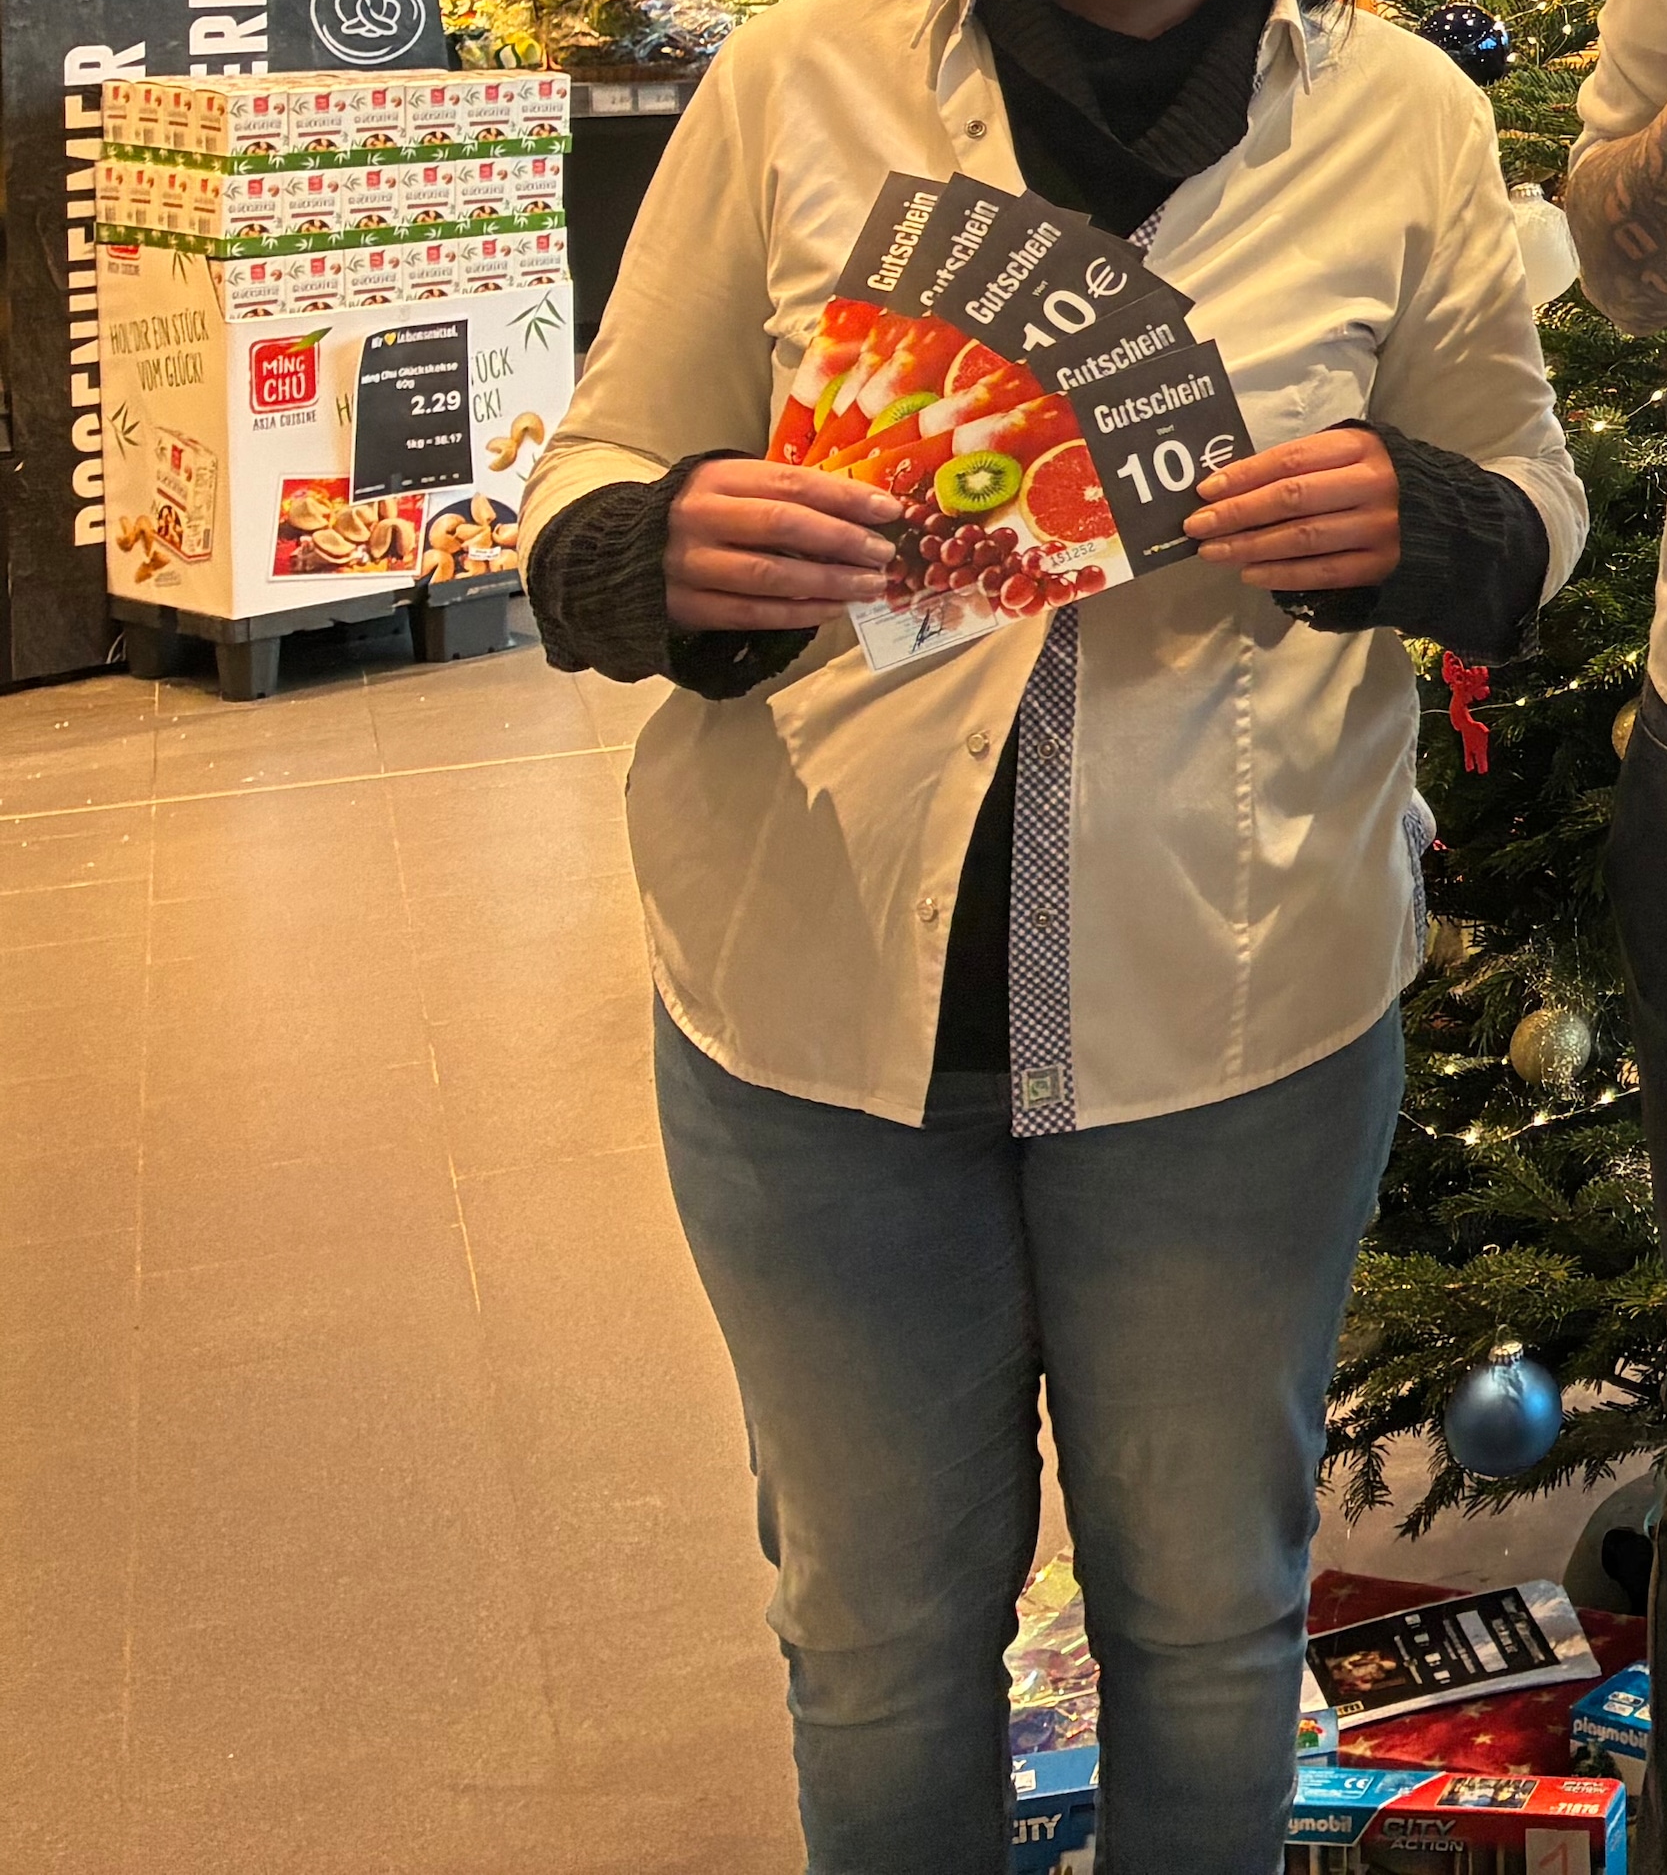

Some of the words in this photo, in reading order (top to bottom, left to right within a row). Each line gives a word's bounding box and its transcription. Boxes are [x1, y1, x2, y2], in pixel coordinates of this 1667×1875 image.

[867, 190, 938, 293] Gutschein
[964, 220, 1062, 326] Gutschein
[172, 308, 210, 345] STÜCK
[137, 357, 162, 392] VOM
[165, 351, 204, 388] GLÜCK!
[470, 346, 514, 386] ÜCK
[1056, 320, 1176, 392] Gutschein
[253, 416, 277, 431] ASIA
[280, 410, 317, 427] CUISINE
[411, 390, 462, 416] 2.29
[472, 388, 503, 424] CK!
[1094, 373, 1215, 436] Gutschein
[1050, 542, 1097, 568] 151252
[1573, 1716, 1649, 1750] playmobil
[1287, 1815, 1353, 1835] ymobil
[1556, 1802, 1600, 1815] 71876
[1382, 1817, 1457, 1836] CITY
[1390, 1839, 1465, 1853] ACTION
